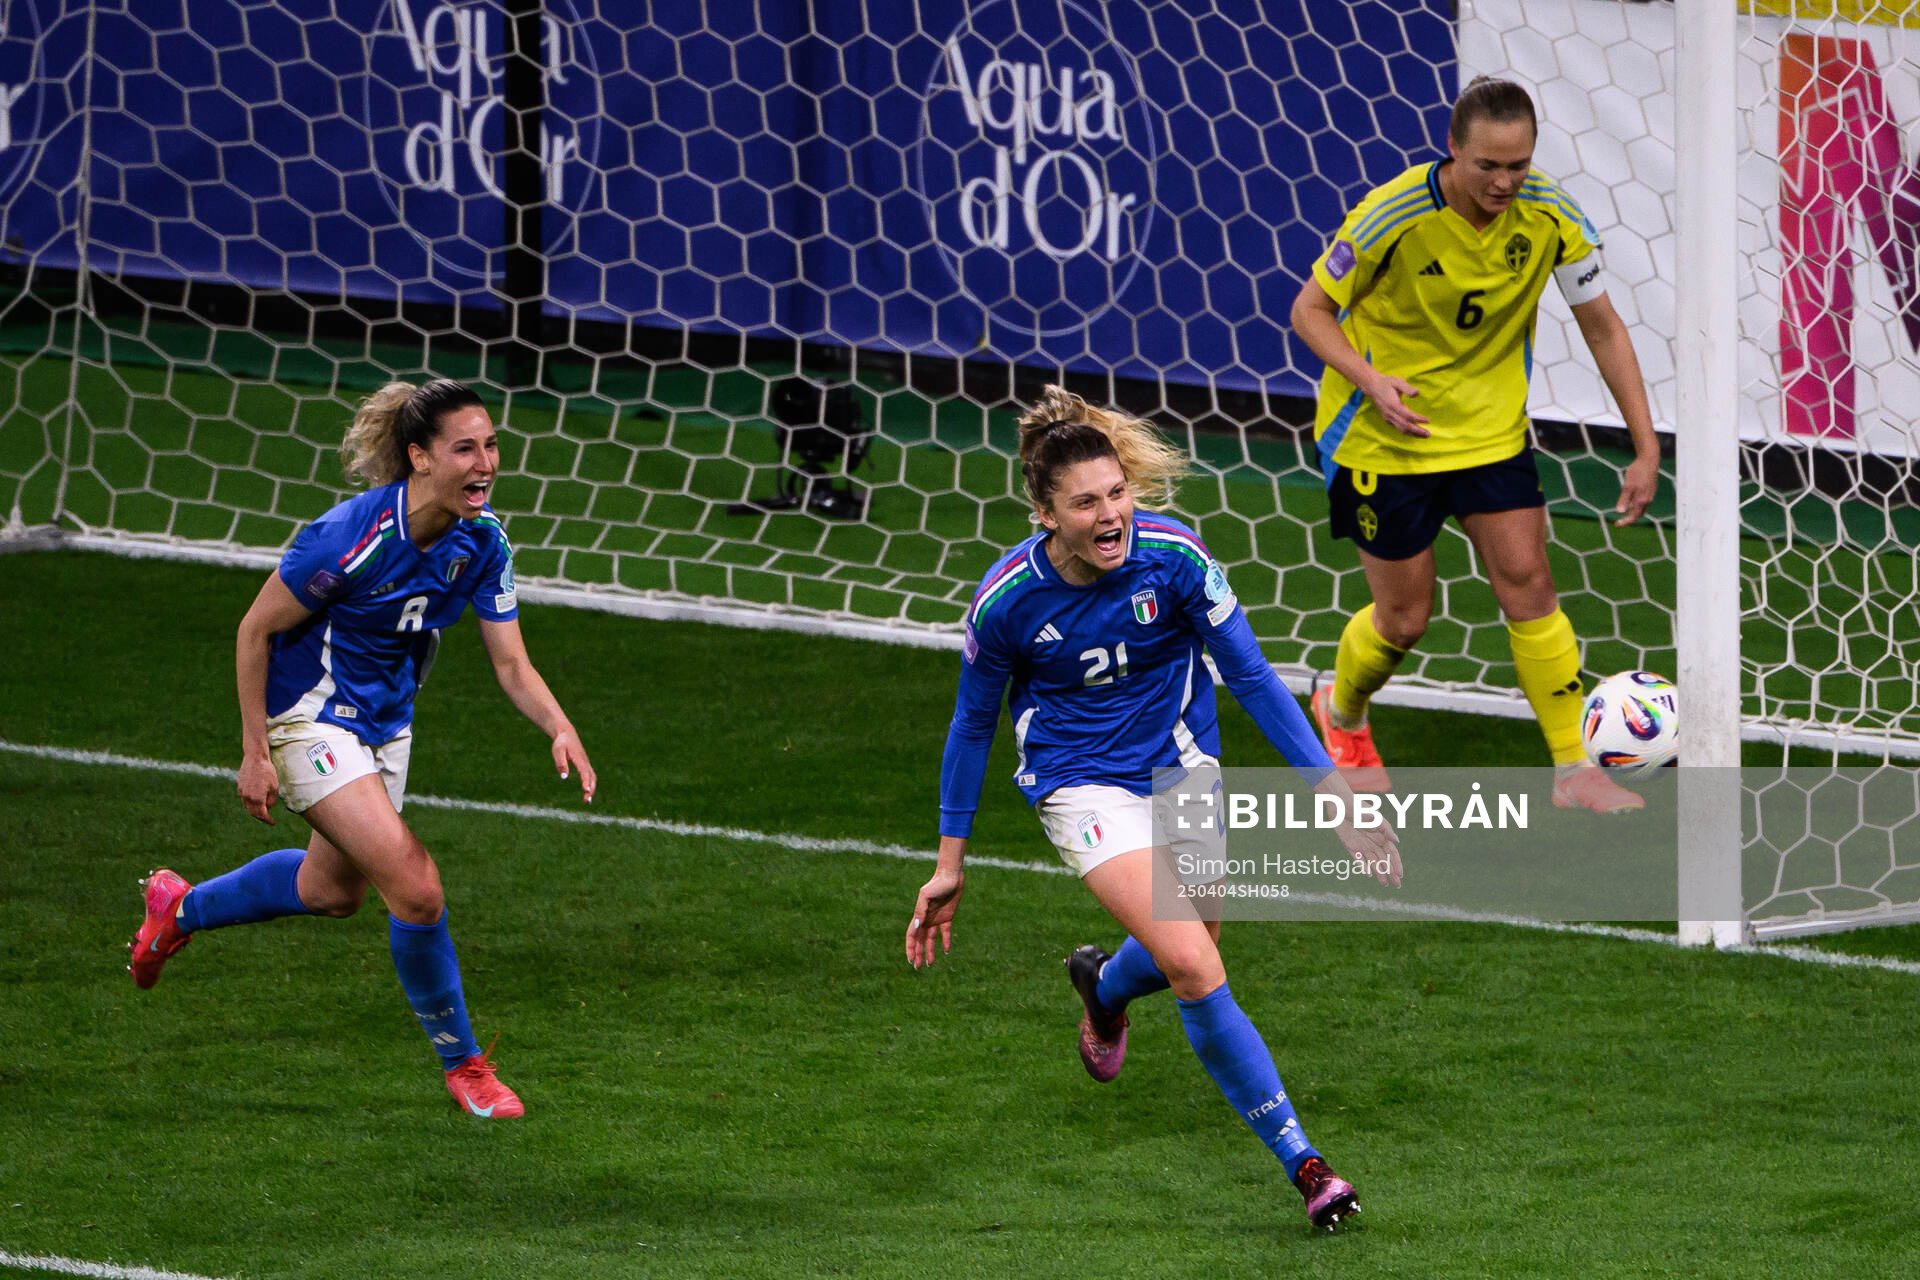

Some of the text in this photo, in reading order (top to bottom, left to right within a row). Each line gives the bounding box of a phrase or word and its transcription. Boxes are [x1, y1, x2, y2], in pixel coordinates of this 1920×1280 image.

[932, 36, 1122, 163] Aqua
[1456, 289, 1485, 330] 6
[1079, 641, 1128, 687] 21
[309, 743, 327, 758] ITALIA
[1247, 1090, 1287, 1121] ITALIA
